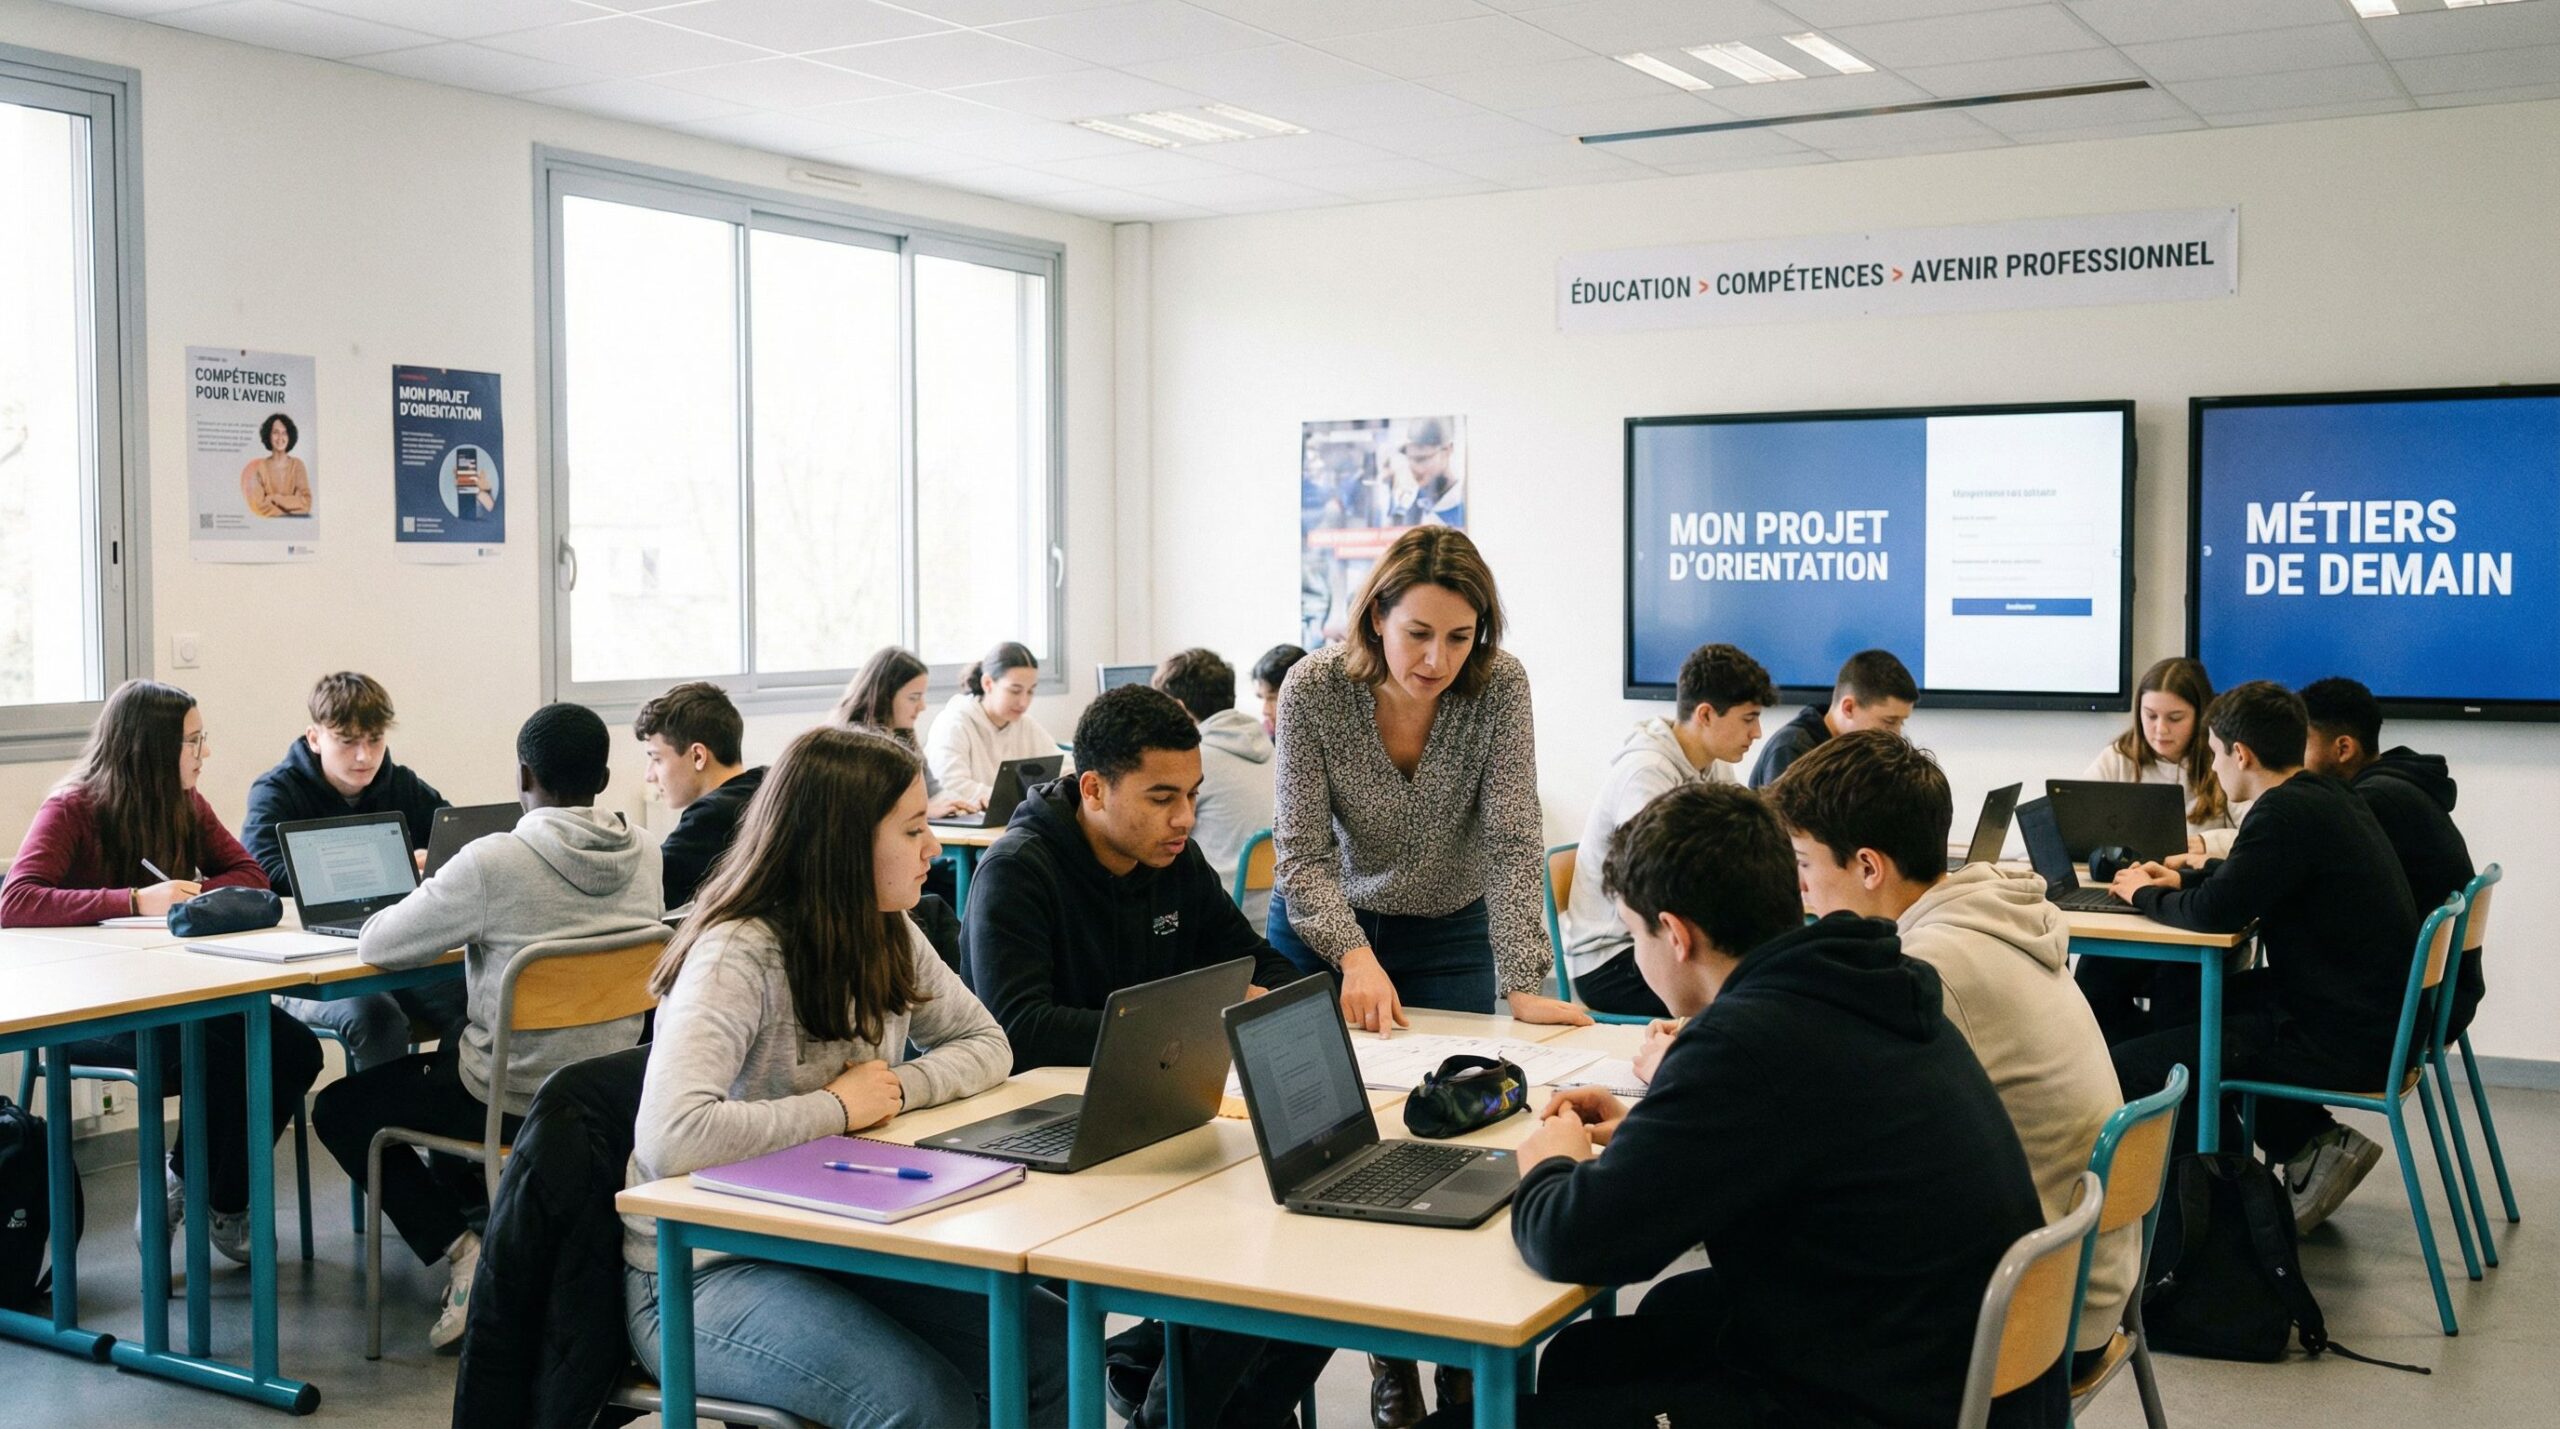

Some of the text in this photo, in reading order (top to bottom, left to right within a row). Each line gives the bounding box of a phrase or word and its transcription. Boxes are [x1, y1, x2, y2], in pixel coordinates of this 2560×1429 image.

[1571, 276, 1691, 304] ÉDUCATION
[1716, 263, 1884, 296] COMPÉTENCES
[1910, 256, 1999, 284] AVENIR
[2006, 241, 2215, 278] PROFESSIONNEL
[195, 367, 286, 387] COMPÉTENCES
[196, 385, 285, 404] POUR L'AVENIR
[399, 386, 426, 401] MON
[400, 402, 481, 420] D'ORIENTATION
[1669, 510, 1889, 546] MON PROJET
[2246, 491, 2457, 544] MÉTIERS
[1669, 550, 1888, 581] D'ORIENTATION
[2245, 552, 2513, 595] DE DEMAIN
